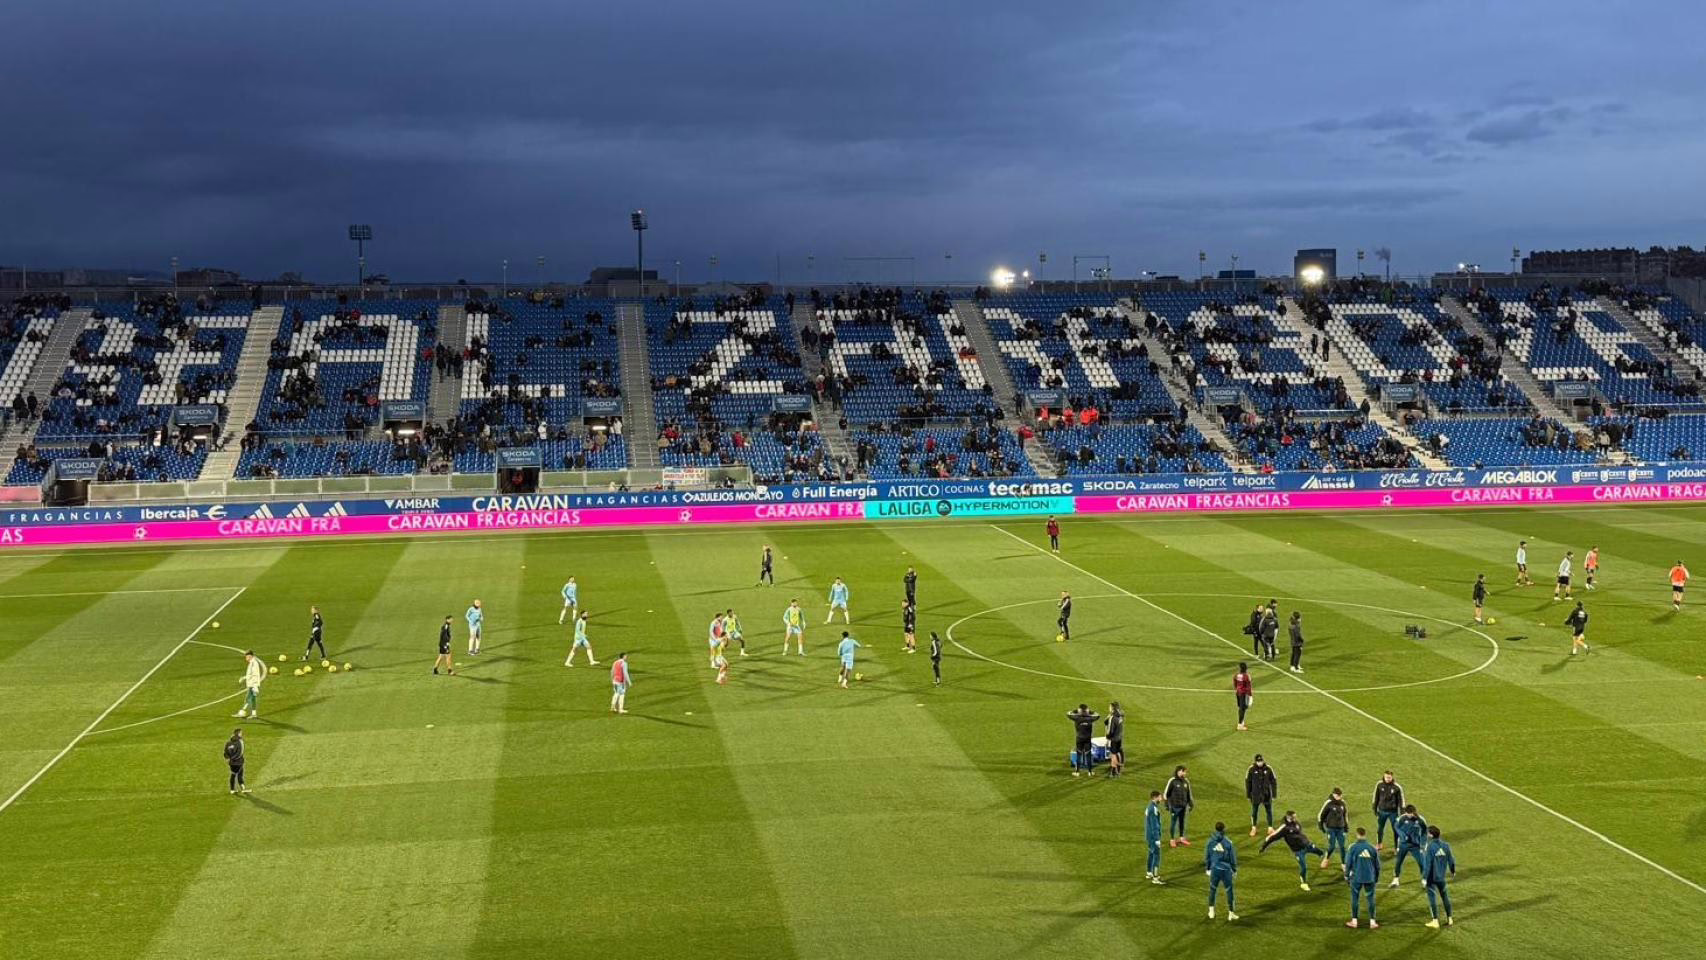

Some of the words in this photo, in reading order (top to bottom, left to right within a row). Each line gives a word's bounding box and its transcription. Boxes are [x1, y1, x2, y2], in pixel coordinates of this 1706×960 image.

[61, 461, 96, 469] SKODA
[1183, 476, 1227, 488] telpark
[1232, 475, 1275, 487] telpark
[1481, 471, 1557, 484] MEGABLOK
[803, 486, 826, 498] Full
[829, 485, 877, 500] Energía
[888, 484, 939, 497] ARTICO
[945, 485, 985, 494] COCINAS
[1083, 481, 1136, 490] SKODA
[1593, 486, 1660, 499] CARAVAN
[1668, 484, 1706, 497] FRAG
[693, 491, 734, 502] AZULEJOS
[735, 490, 784, 501] MONCAYO
[1116, 495, 1188, 509] CARAVAN
[1196, 494, 1290, 508] FRAGANCIAS
[1452, 488, 1522, 502] CARAVAN
[1529, 487, 1554, 500] FRA
[395, 498, 440, 509] AMBAR
[472, 495, 569, 512] CARAVAN
[577, 494, 678, 506] FRAGANCIAS
[755, 503, 830, 518] CARAVAN
[838, 501, 864, 516] FRA
[879, 502, 931, 515] LALIGA
[954, 500, 1050, 512] HYPERMOTION
[10, 511, 123, 523] FRAGANCIAS
[141, 507, 199, 521] Ibercaja
[388, 514, 469, 529] CARAVAN
[477, 510, 581, 528] FRAGANCIAS
[218, 519, 302, 535] CARAVAN
[311, 518, 341, 531] FRA
[1, 528, 24, 543] AS
